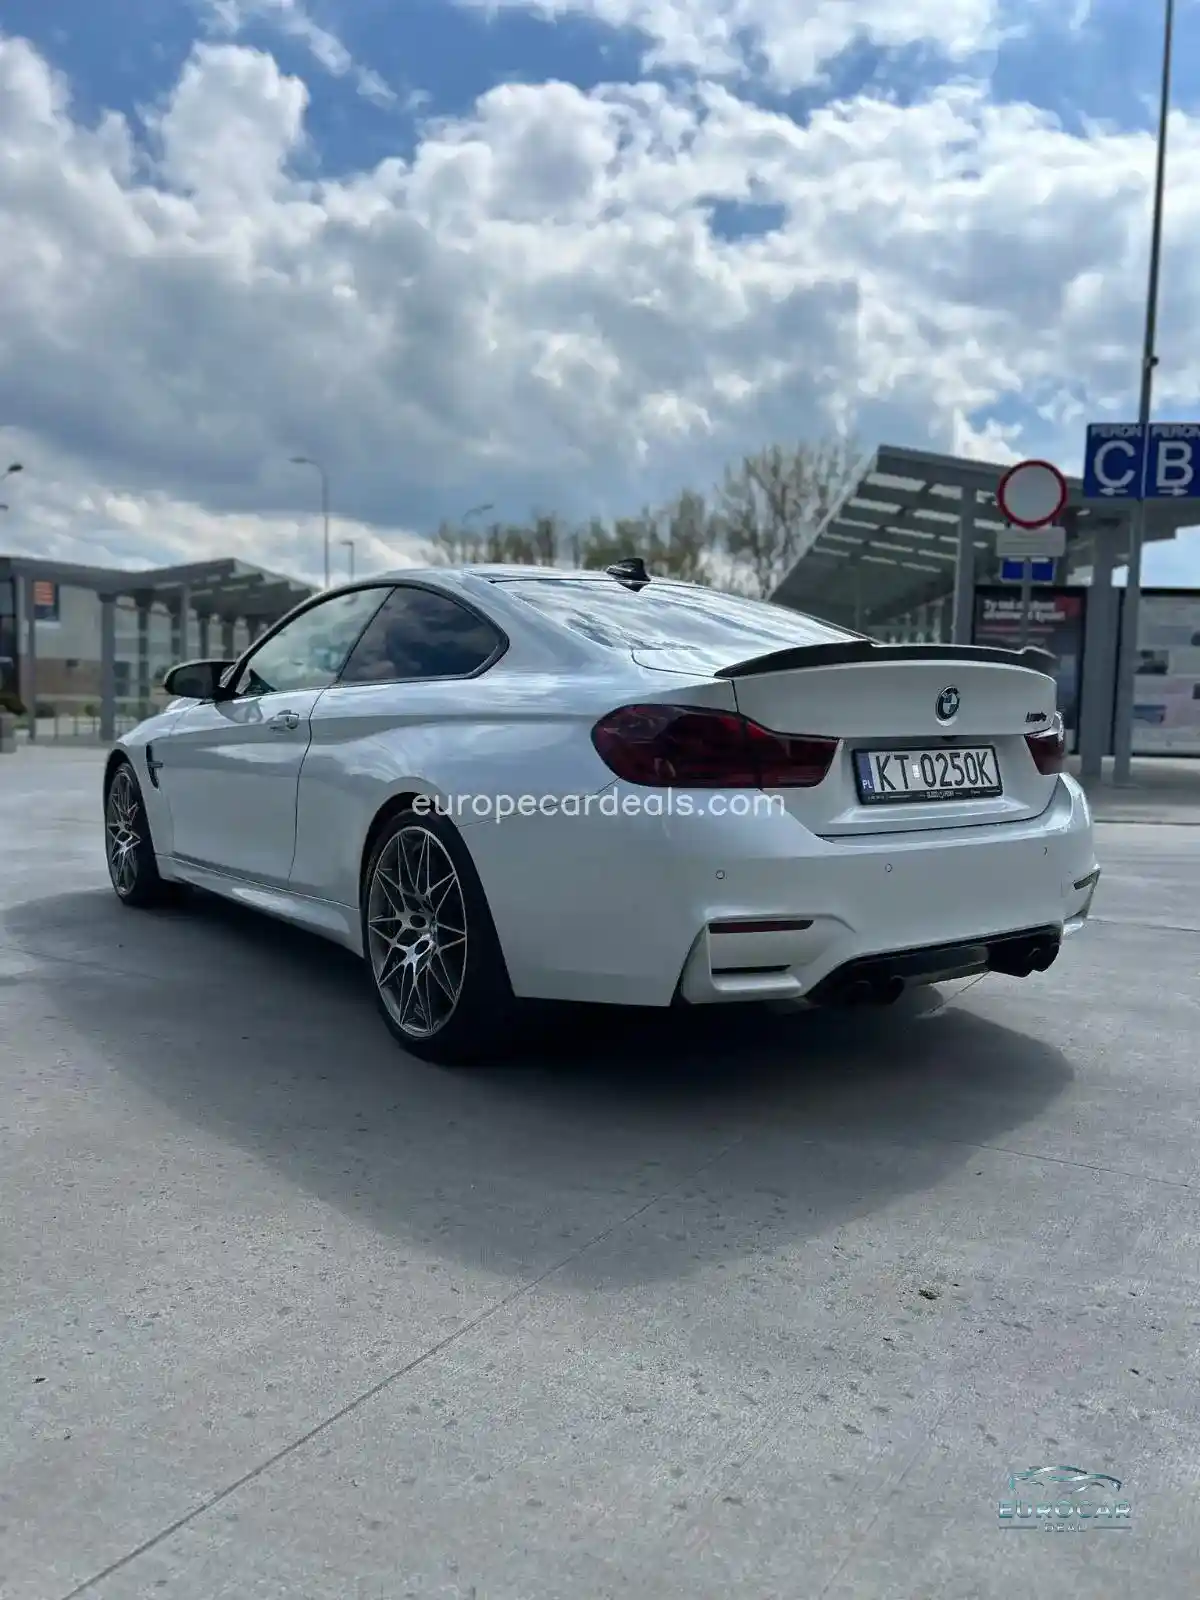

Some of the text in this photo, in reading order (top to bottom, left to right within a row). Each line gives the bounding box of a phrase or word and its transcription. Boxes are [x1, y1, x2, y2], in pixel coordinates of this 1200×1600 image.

[1091, 425, 1142, 438] PERON
[1094, 440, 1136, 488] C
[1156, 440, 1194, 487] B
[861, 780, 873, 789] PL
[875, 751, 993, 791] KT 0250K
